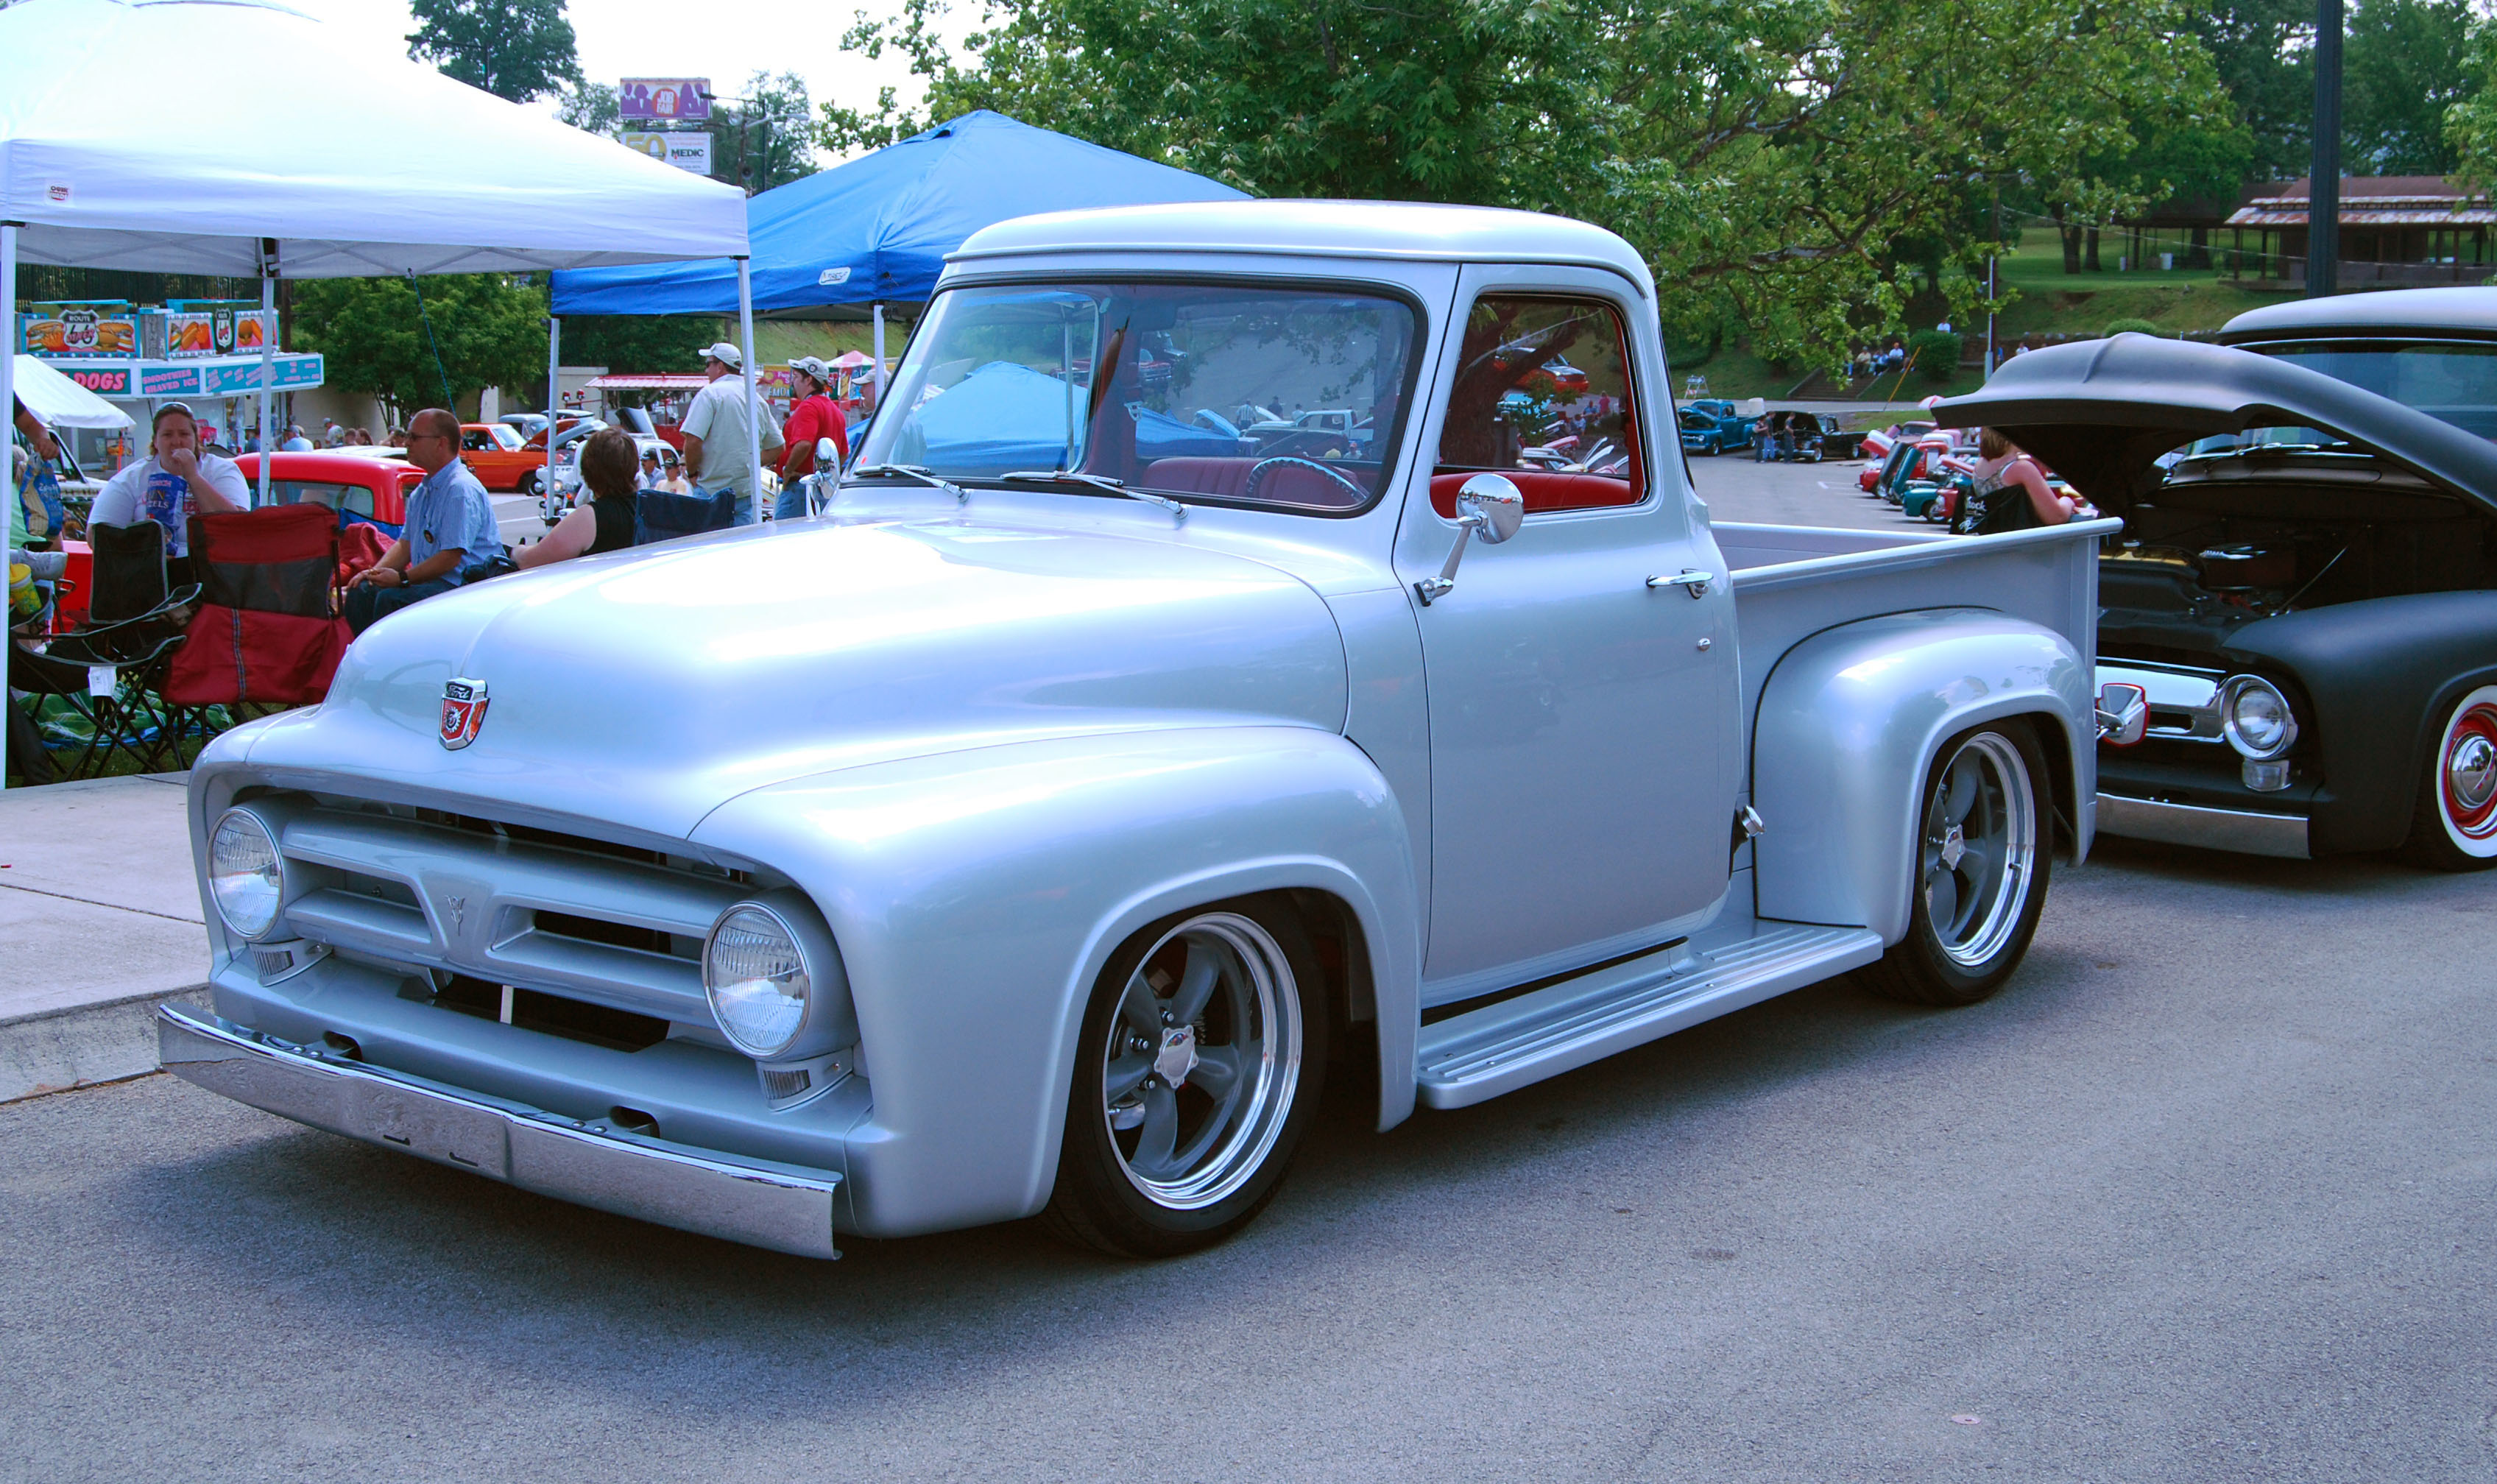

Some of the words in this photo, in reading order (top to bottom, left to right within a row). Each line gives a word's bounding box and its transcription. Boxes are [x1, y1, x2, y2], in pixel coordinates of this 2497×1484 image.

[658, 90, 674, 103] JOB
[657, 102, 674, 114] FAIR
[671, 149, 704, 158] MEDIC
[66, 329, 95, 343] DINER
[69, 324, 93, 344] 66
[74, 372, 126, 391] DOGS
[143, 369, 192, 385] SMOOTHIES
[144, 381, 180, 395] SHAVED
[448, 684, 470, 699] Ford
